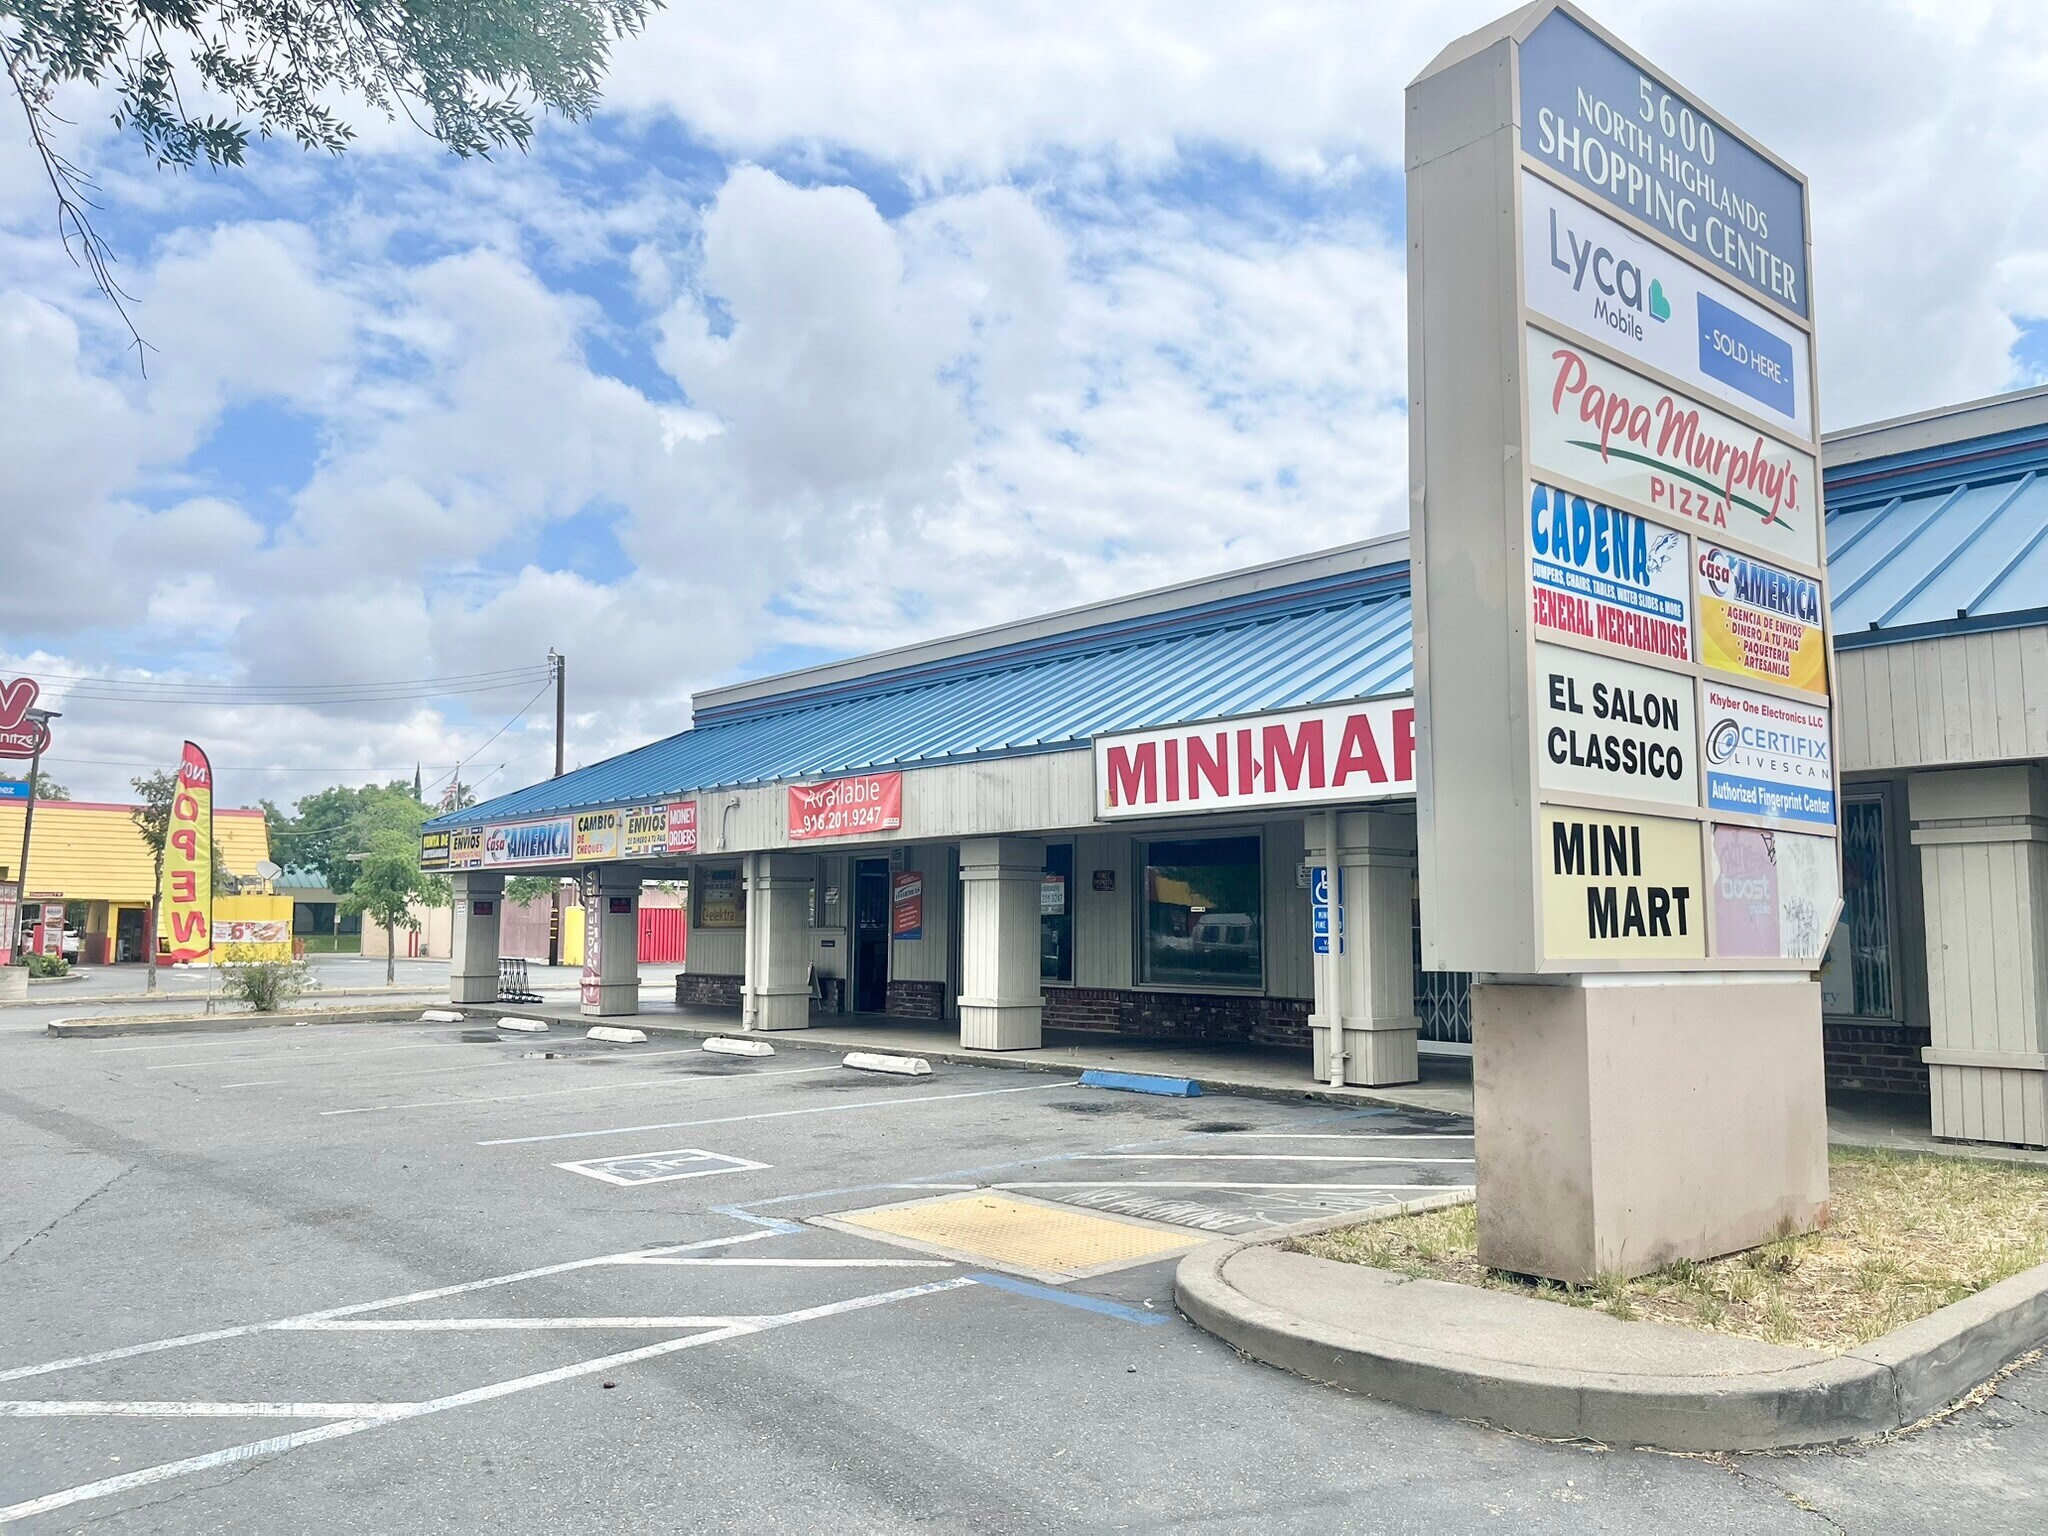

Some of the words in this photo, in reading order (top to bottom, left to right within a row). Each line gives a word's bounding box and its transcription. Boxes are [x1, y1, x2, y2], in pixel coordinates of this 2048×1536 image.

[1638, 75, 1715, 166] 5600
[1577, 86, 1652, 165] NORTH
[1659, 143, 1768, 240] HIGHLANDS
[1538, 107, 1698, 243] SHOPPING
[1705, 216, 1798, 305] CENTER
[1549, 207, 1643, 312] Lyca
[1593, 297, 1643, 341] Mobile
[1713, 329, 1748, 365] SOLD
[1751, 350, 1782, 385] HERE
[1551, 350, 1652, 464] Papa
[1655, 396, 1798, 525] Murphy's
[1650, 476, 1727, 529] PIZZA
[1531, 484, 1651, 587] CADENA
[1566, 573, 1592, 593] CHAIRS,
[1592, 580, 1617, 600] TABLES,
[1617, 586, 1638, 605] WATER
[1638, 592, 1658, 611] SLIDES
[1659, 602, 1665, 613] &
[1665, 601, 1682, 617] MORE
[1734, 559, 1820, 625] AMERICA
[1596, 603, 1688, 661] MERCHANDISE
[1727, 606, 1761, 626] AGENCIA
[1764, 616, 1773, 629] DE
[1775, 620, 1802, 638] ENVIOS
[1732, 623, 1762, 640] DINERO
[1764, 631, 1770, 643] A
[1772, 633, 1780, 647] TU
[1783, 636, 1799, 652] PAIS
[1743, 640, 1789, 663] PAQUETERIA
[1744, 655, 1790, 677] ARTESANIAS
[1548, 673, 1583, 715] EL
[1593, 682, 1679, 731] SALON
[1710, 692, 1741, 710] Khyber
[1743, 701, 1759, 715] One
[1761, 705, 1807, 725] Electronics
[1808, 715, 1824, 728] LLC
[1547, 727, 1683, 781] CLASSICO
[1741, 726, 1827, 760] CERTIFIX
[1107, 728, 1253, 807] MINI
[804, 777, 880, 809] Available
[1712, 780, 1757, 804] Authorized
[1758, 787, 1802, 813] Fingerprint
[1804, 794, 1830, 814] Center
[578, 814, 615, 832] CAMBIO
[628, 814, 666, 834] ENVIOS
[670, 807, 695, 825] MONEY
[804, 806, 882, 832] 916.201.9247
[454, 835, 480, 850] ENVIOS
[507, 823, 570, 858] AMERICA
[577, 834, 585, 844] DE
[577, 843, 603, 854] CHEQUES
[669, 829, 696, 846] ORDERS
[1552, 821, 1642, 877] MINI
[1721, 874, 1771, 899] boost
[1587, 886, 1690, 939] MART
